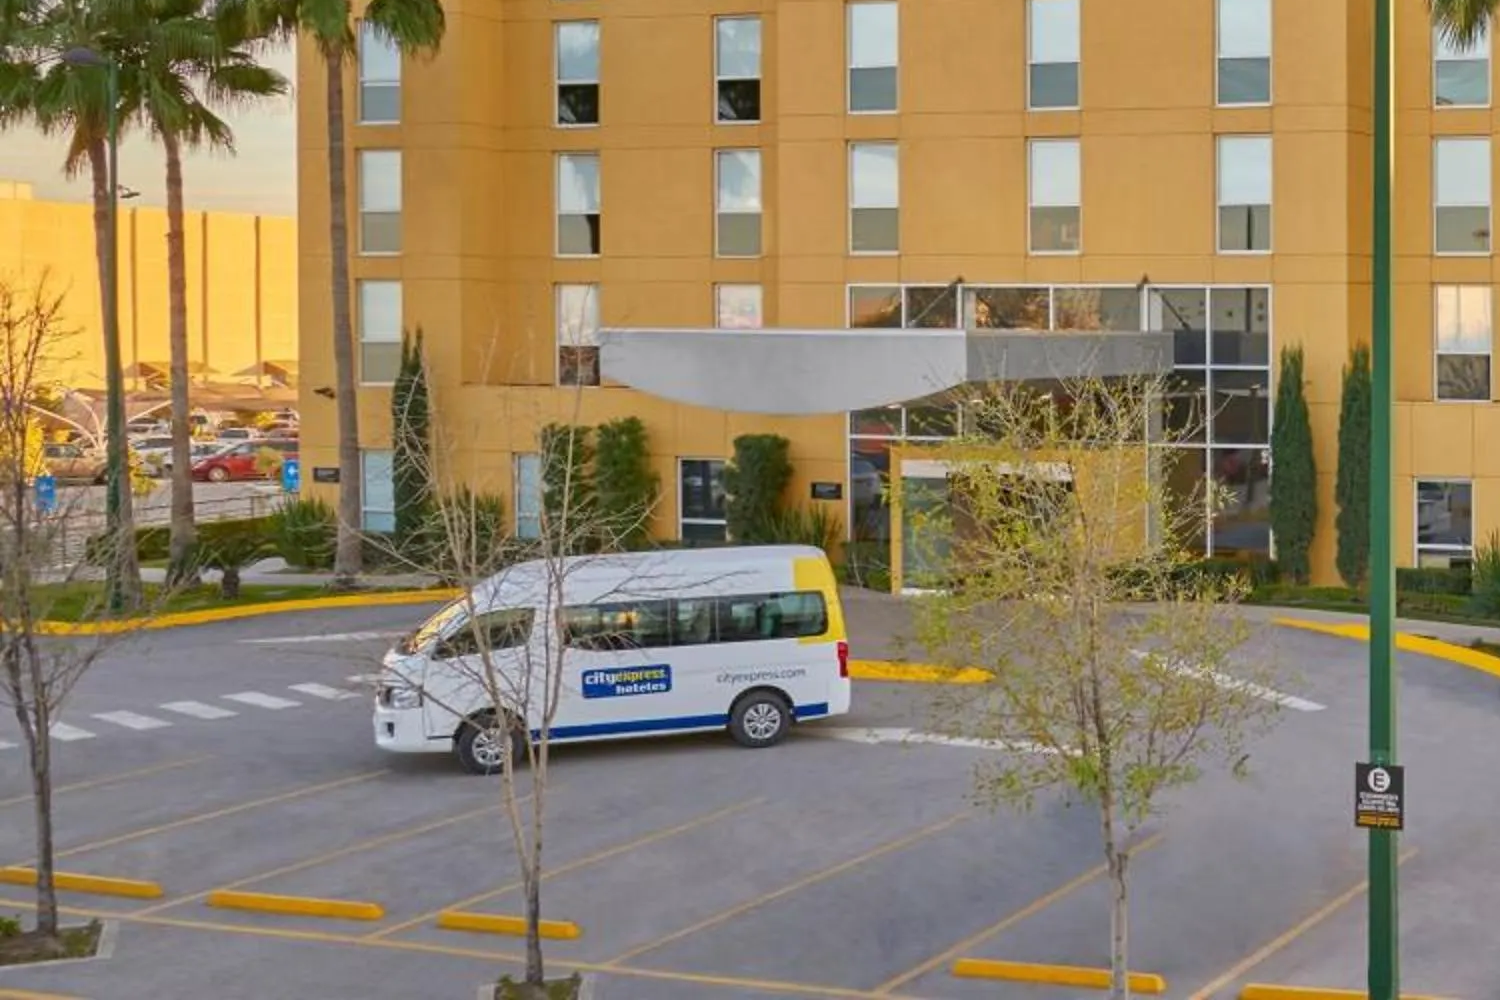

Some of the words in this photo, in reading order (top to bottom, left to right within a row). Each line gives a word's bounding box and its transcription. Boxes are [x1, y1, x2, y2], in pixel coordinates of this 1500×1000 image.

[716, 668, 806, 686] cityexpress.com
[615, 682, 667, 694] hoteles
[1373, 771, 1385, 789] E
